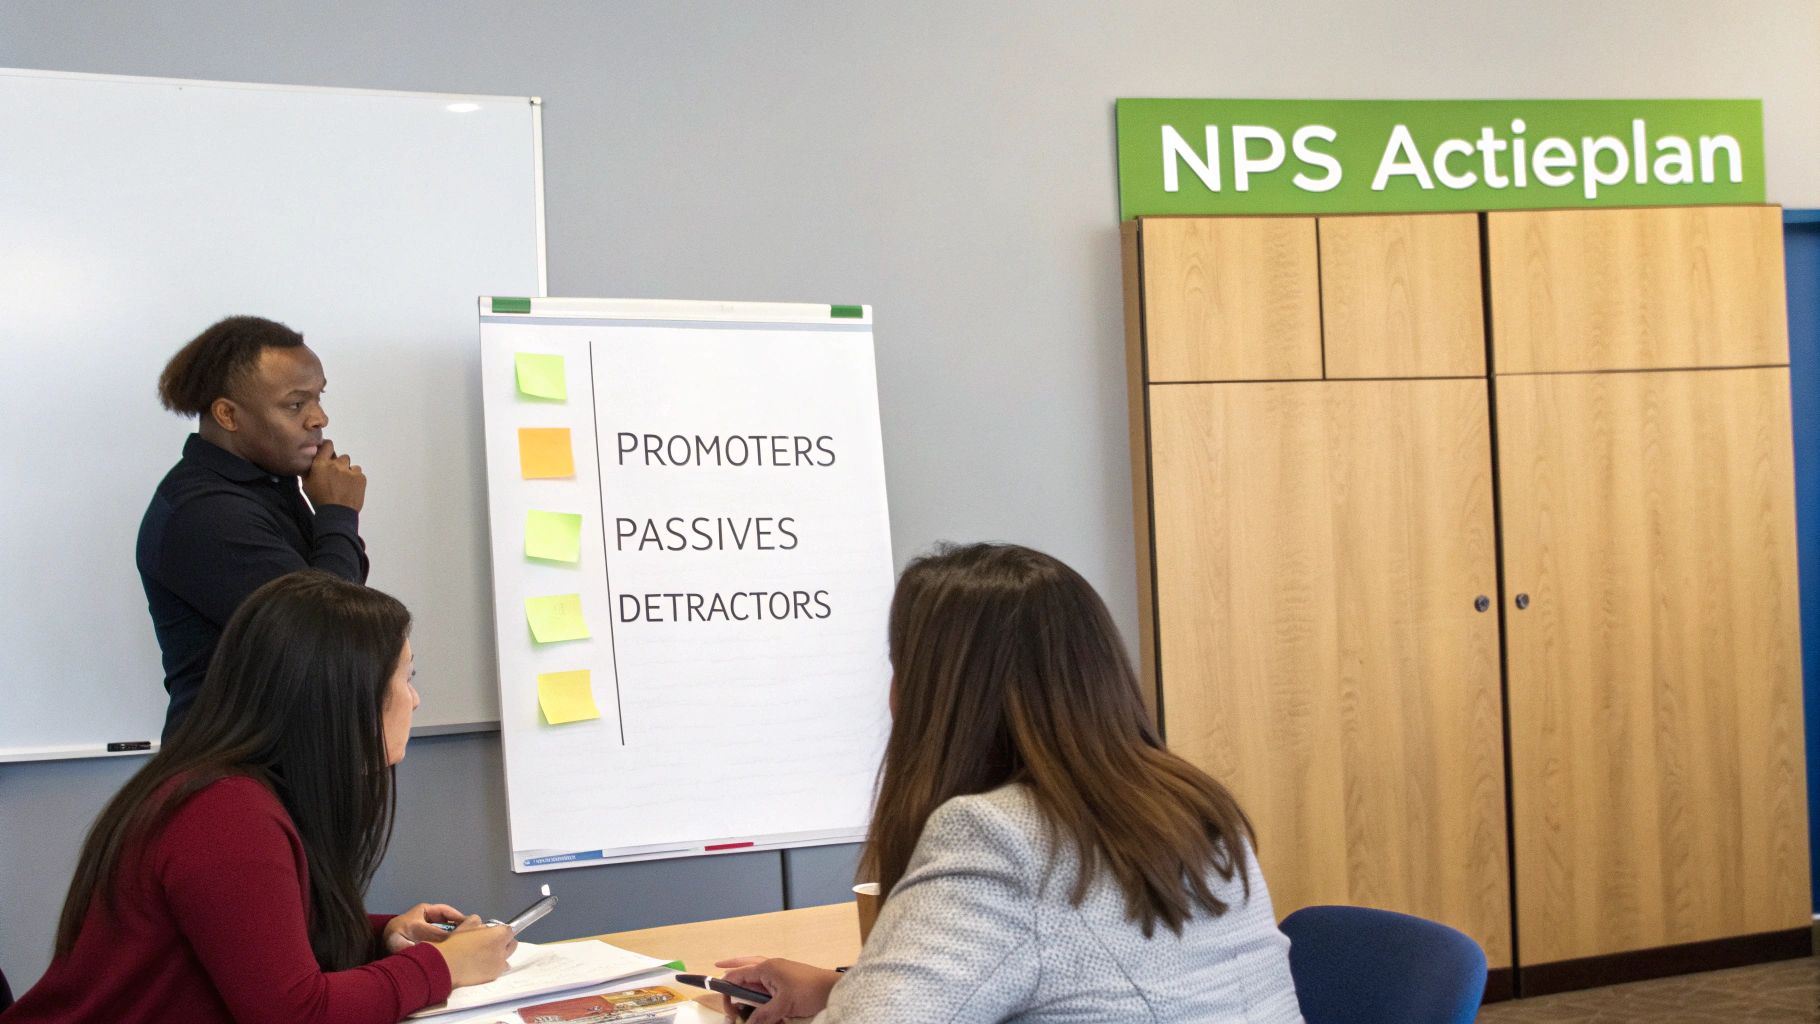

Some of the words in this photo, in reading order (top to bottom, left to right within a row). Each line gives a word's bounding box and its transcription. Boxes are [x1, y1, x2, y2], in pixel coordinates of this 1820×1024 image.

[1161, 124, 1342, 192] NPS
[1371, 118, 1742, 199] Actieplan
[617, 432, 836, 466] PROMOTERS
[616, 517, 798, 551] PASSIVES
[619, 590, 832, 622] DETRACTORS
